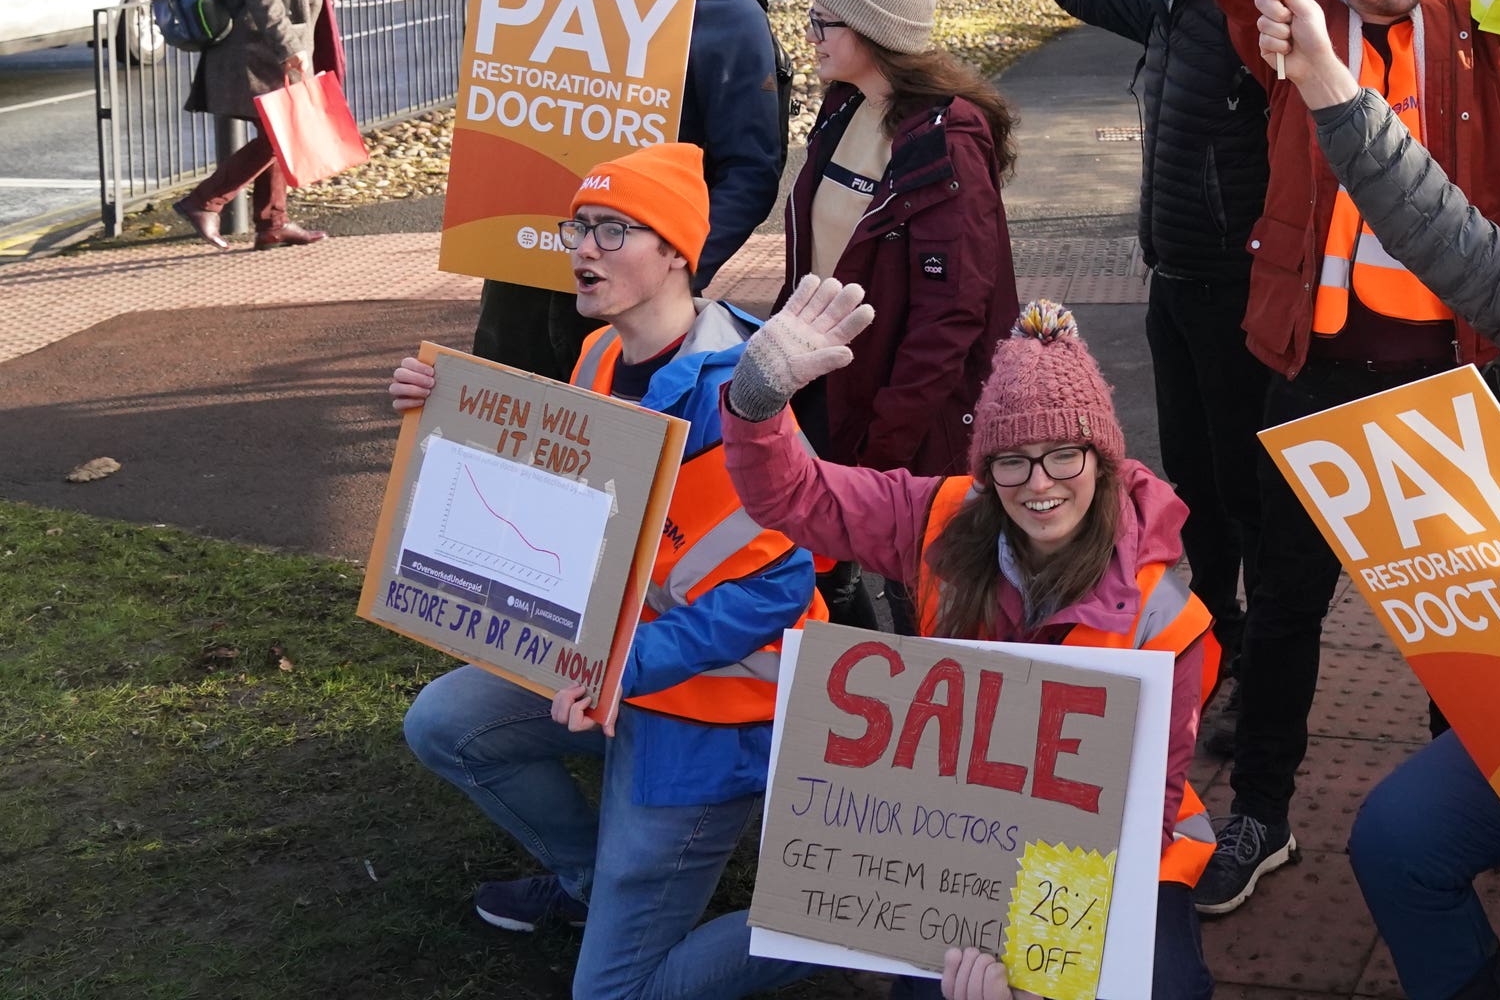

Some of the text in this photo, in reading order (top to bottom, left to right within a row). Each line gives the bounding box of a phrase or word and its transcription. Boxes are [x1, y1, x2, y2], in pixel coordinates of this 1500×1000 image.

[472, 59, 671, 108] RESTORATION FOR
[467, 85, 667, 147] DOCTORS
[851, 178, 875, 193] FILA
[459, 384, 591, 446] WHEN WILL
[497, 428, 528, 457] IT
[534, 437, 591, 481] END?
[411, 560, 483, 593] #OverworkedUnderpaid
[513, 597, 530, 613] BMA
[386, 580, 603, 693] RESTORE JR DR PAY NOW!
[824, 640, 1108, 814] SALE
[791, 776, 1018, 852] JUNIOR DOCTORS
[782, 838, 1002, 901] GET THEM BEFORE
[801, 890, 912, 932] THEY'RE
[1030, 880, 1098, 932] 26%
[1026, 943, 1082, 974] OFF
